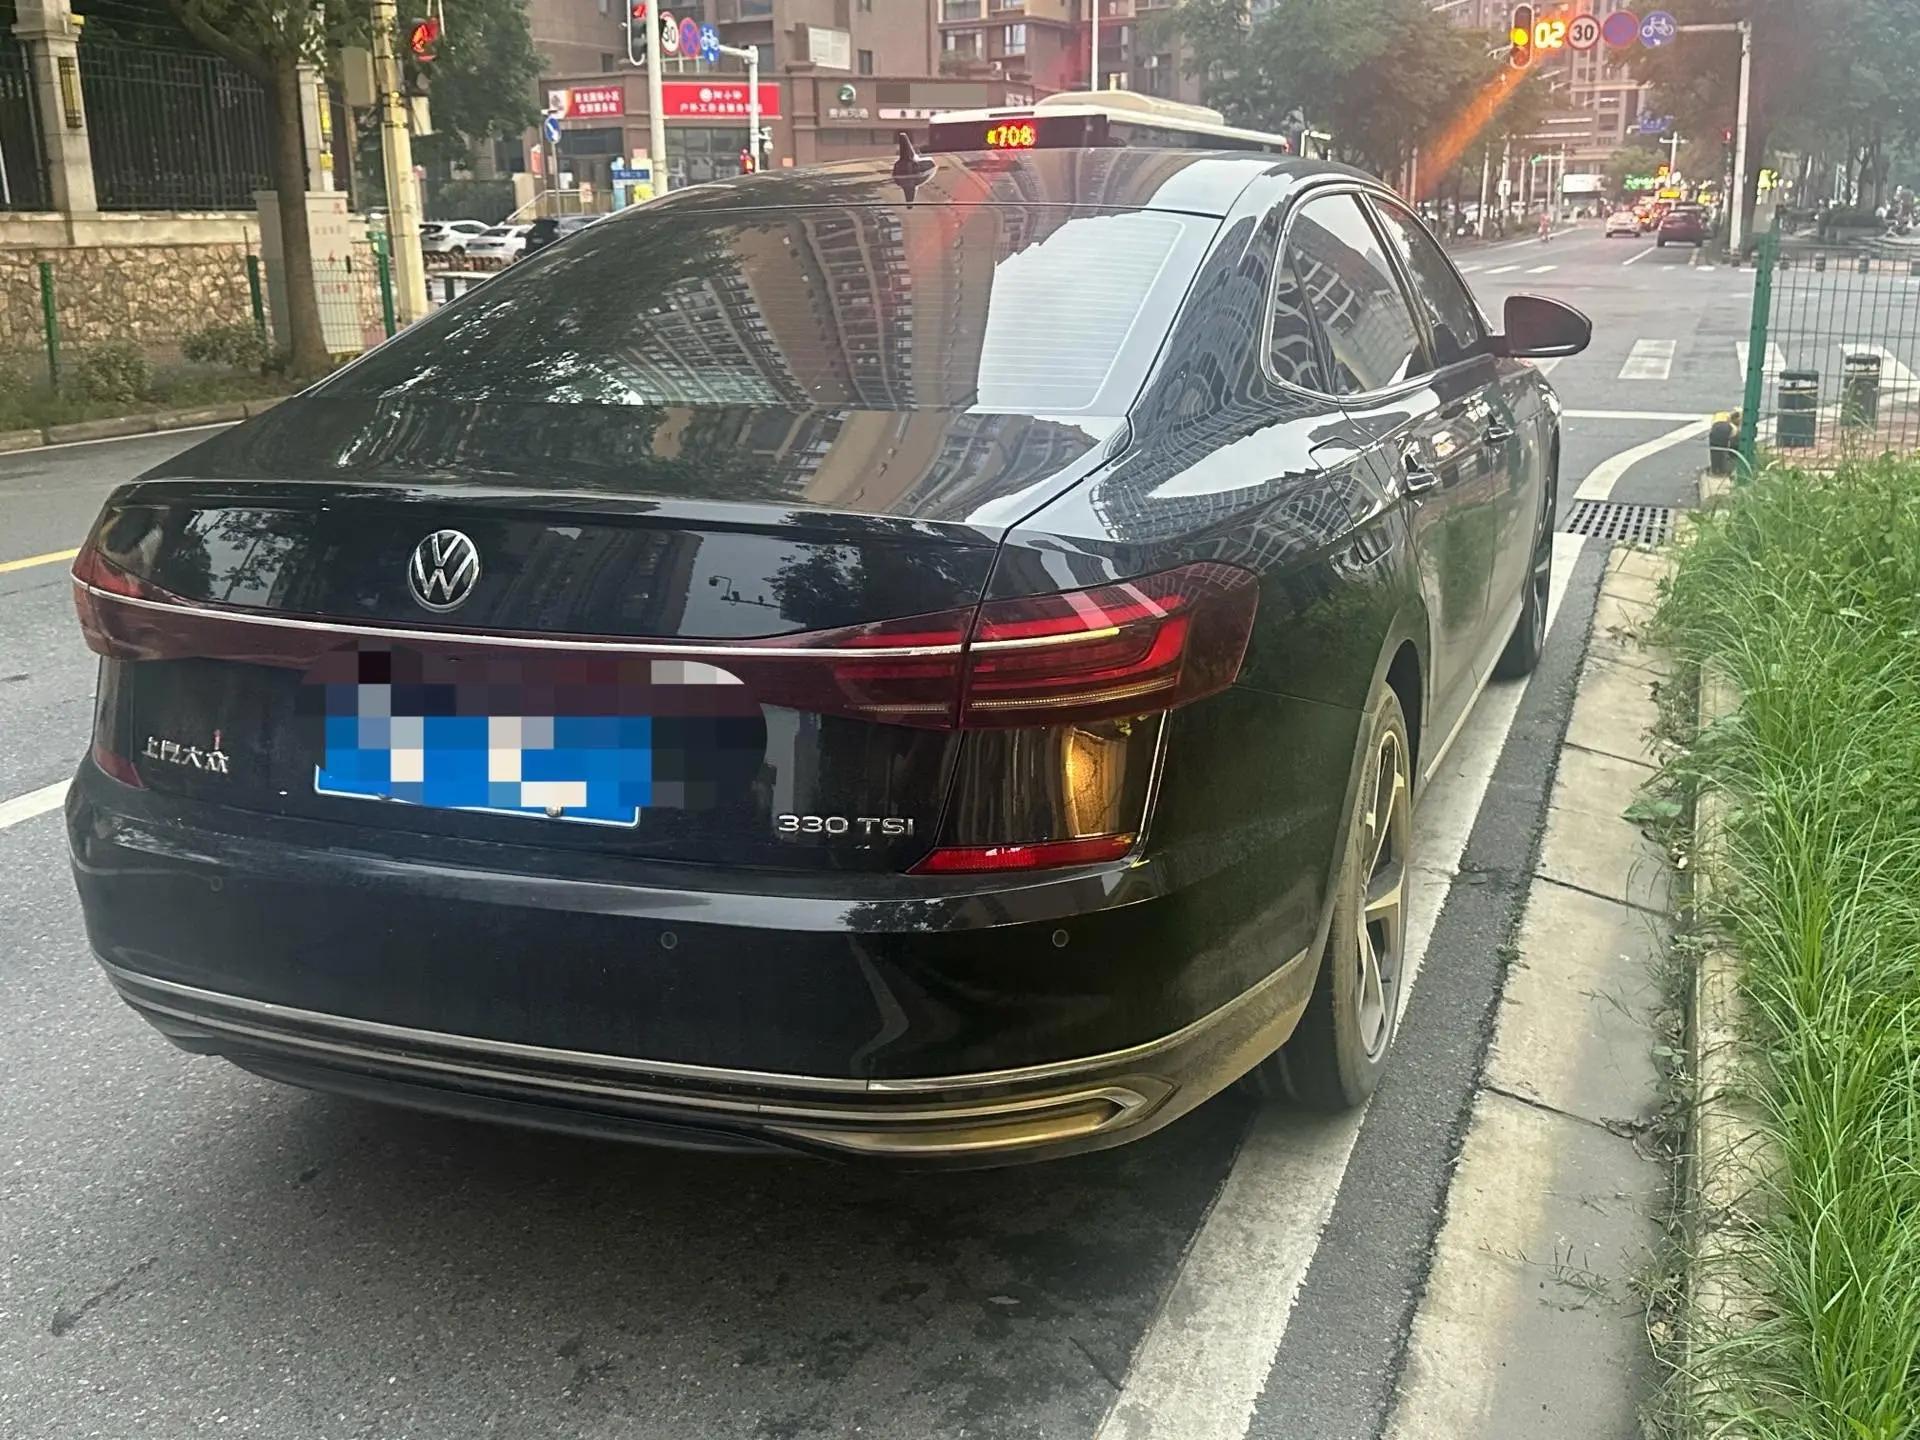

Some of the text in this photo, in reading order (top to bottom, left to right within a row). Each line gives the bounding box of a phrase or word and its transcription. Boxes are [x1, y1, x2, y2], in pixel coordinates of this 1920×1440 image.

[1573, 25, 1594, 41] 30
[778, 814, 914, 835] 330 TSI
